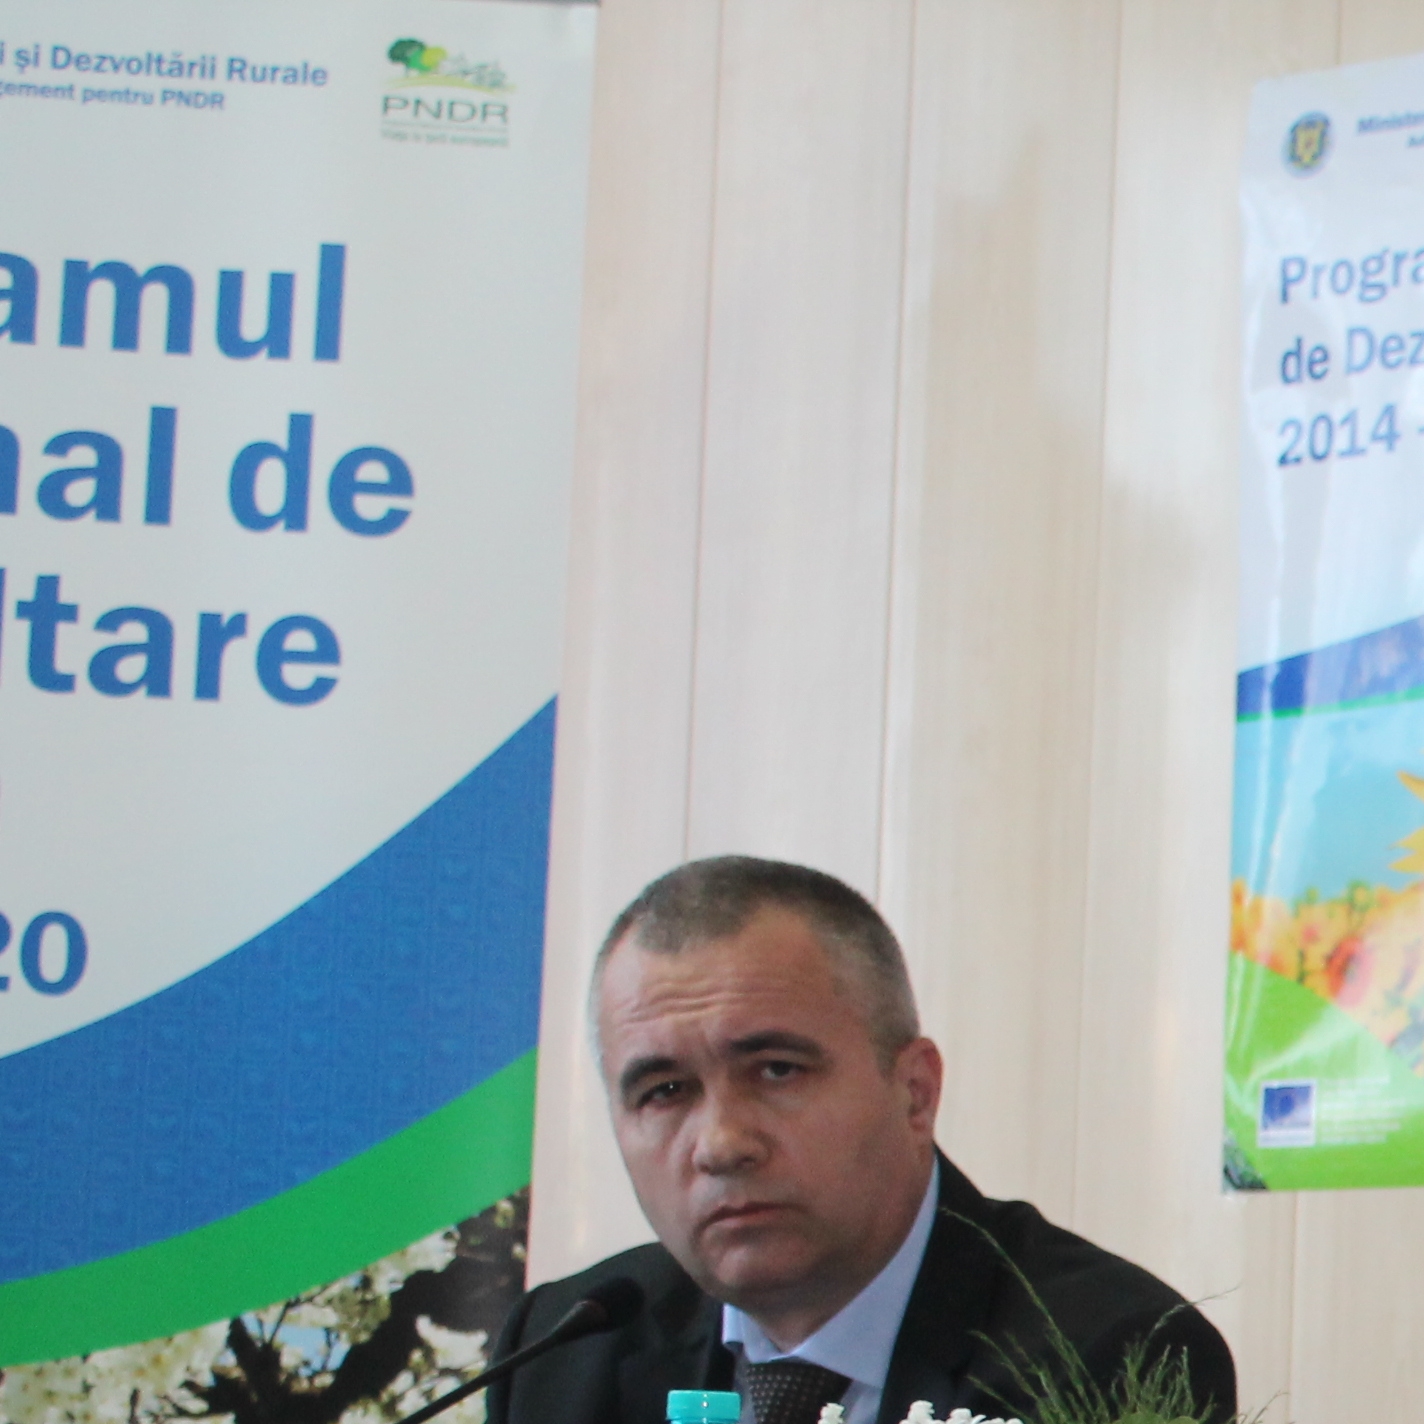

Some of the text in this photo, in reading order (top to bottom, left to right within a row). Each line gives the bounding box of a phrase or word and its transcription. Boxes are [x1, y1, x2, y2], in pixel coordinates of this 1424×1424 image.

[51, 45, 217, 81] Dezvoltării
[227, 56, 329, 87] Rurale
[81, 86, 155, 106] pentru
[161, 88, 226, 111] PNDR
[381, 93, 510, 124] PNDR
[1280, 337, 1330, 386] de
[1276, 403, 1402, 469] 2014
[0, 404, 416, 538] al de
[0, 567, 342, 708] tare
[0, 909, 88, 997] 0
